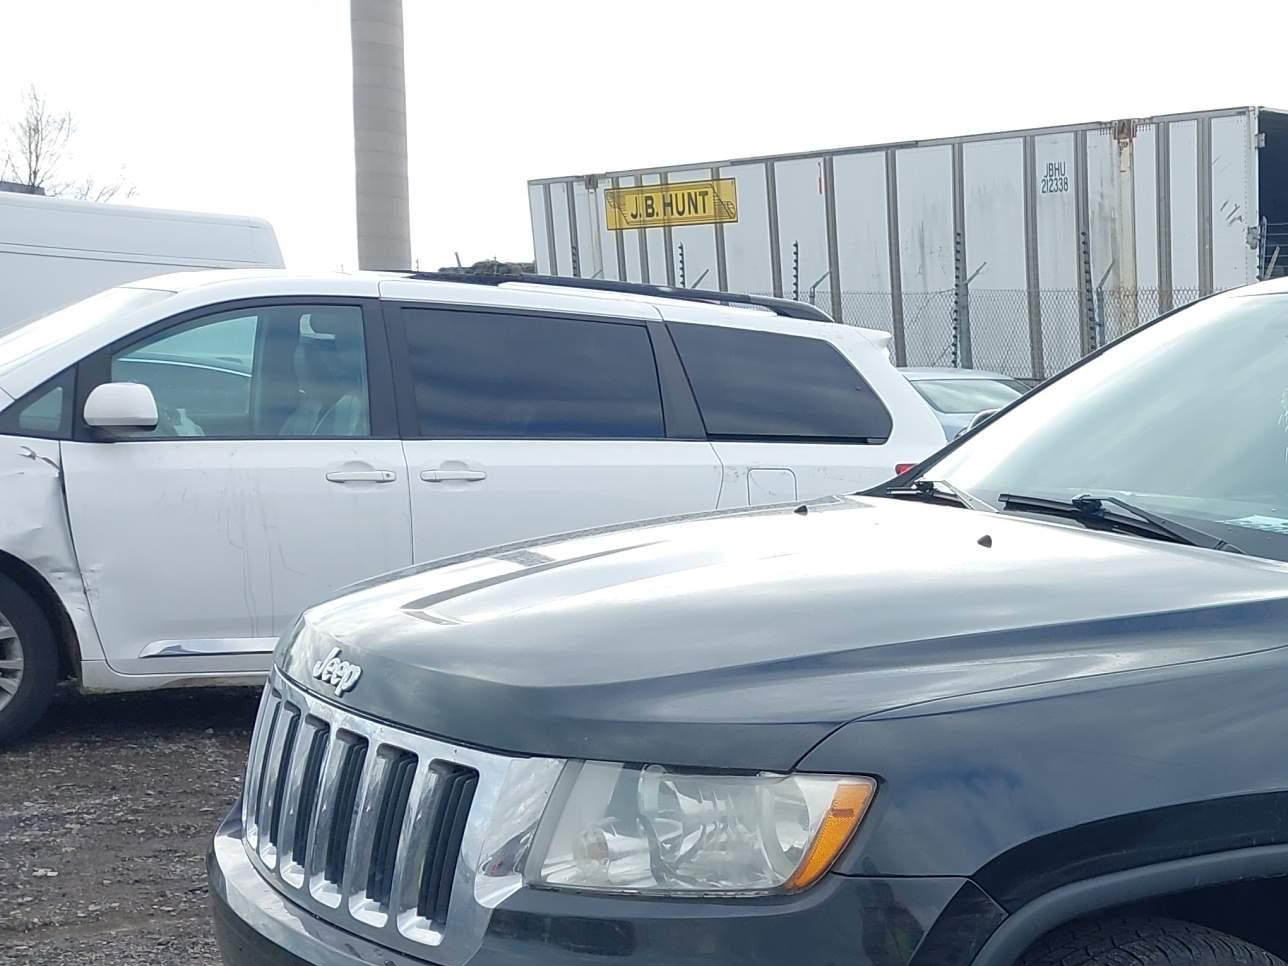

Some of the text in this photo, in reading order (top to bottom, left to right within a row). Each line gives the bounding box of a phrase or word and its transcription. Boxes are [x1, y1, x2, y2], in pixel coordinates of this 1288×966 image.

[1043, 160, 1066, 178] JBHU
[1041, 176, 1069, 194] 212338
[663, 191, 708, 217] HUNT
[312, 646, 362, 697] Jeep
